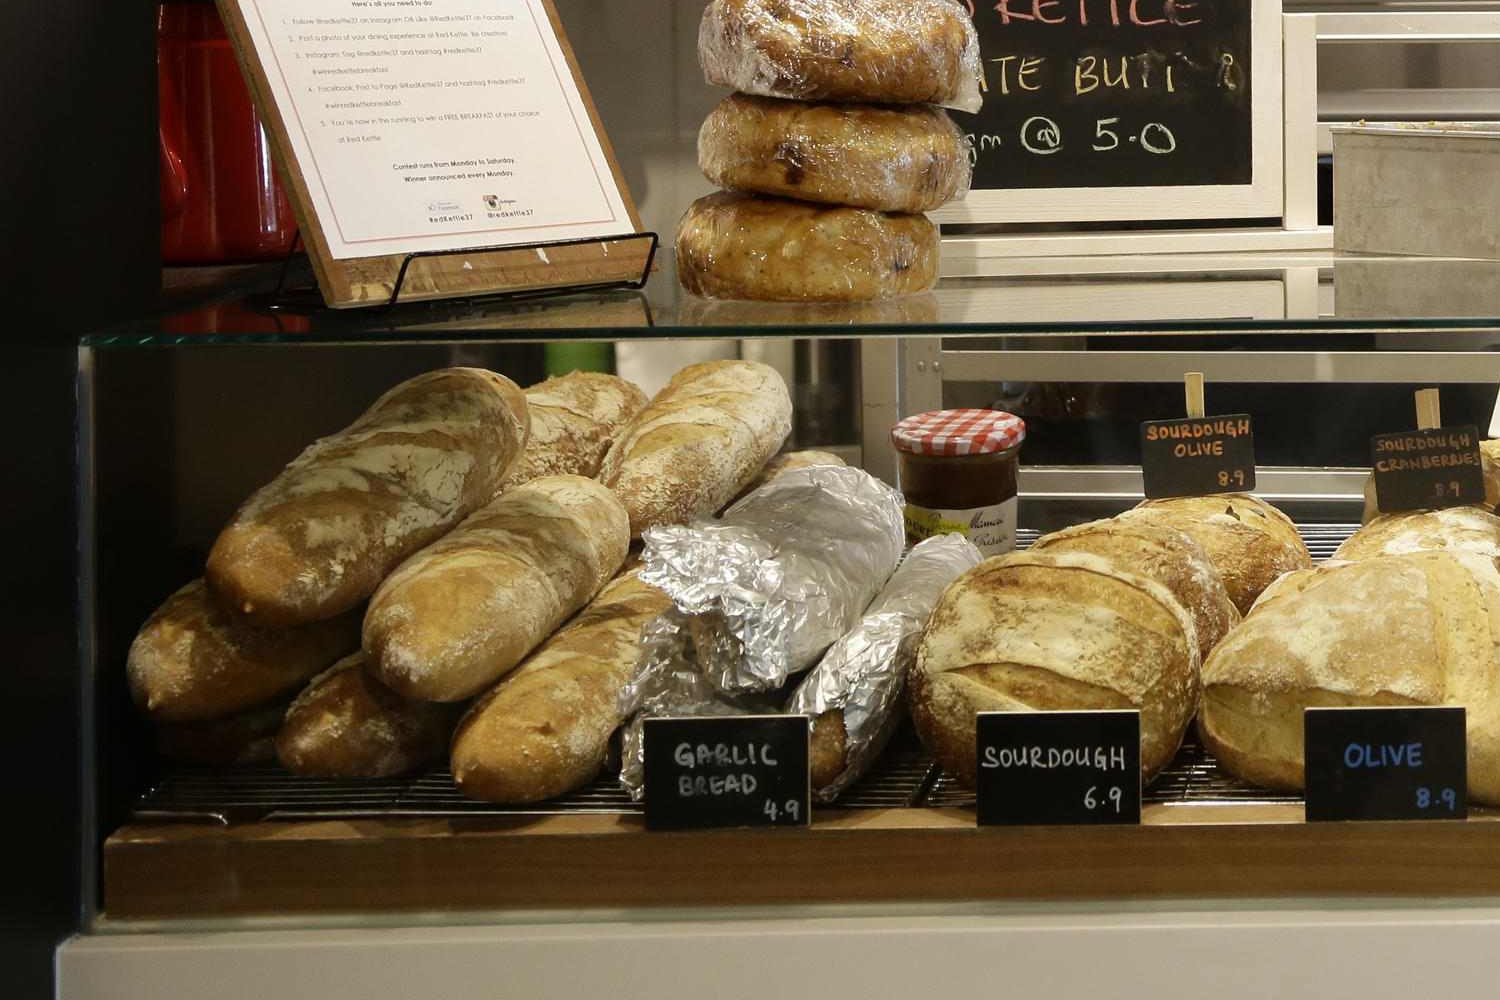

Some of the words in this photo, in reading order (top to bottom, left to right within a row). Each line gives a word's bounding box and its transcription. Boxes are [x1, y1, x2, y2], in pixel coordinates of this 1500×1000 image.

[443, 113, 460, 121] FREE
[460, 111, 494, 120] BREAKFAST
[346, 135, 361, 143] Red
[392, 161, 419, 171] Contest
[434, 160, 450, 168] from
[450, 158, 478, 167] Monday
[403, 175, 427, 183] Winner
[428, 173, 466, 181] announced
[467, 172, 486, 180] every
[428, 213, 473, 223] RedKettle37
[487, 209, 534, 219] @redkettle37
[1146, 418, 1251, 440] SOURDOUGH
[1174, 440, 1224, 458] OLIVE
[1376, 434, 1471, 453] SOURDOUGH
[1375, 451, 1481, 473] CRANBERRIES
[1217, 470, 1245, 487] 8.9
[673, 741, 778, 767] GARLIC
[981, 745, 1126, 771] SOURDOUGH
[1343, 741, 1423, 769] OLIVE
[679, 773, 758, 797] BREAD
[763, 797, 799, 821] 4.9
[1083, 785, 1123, 813] 6.9
[1415, 787, 1456, 811] 8.9
